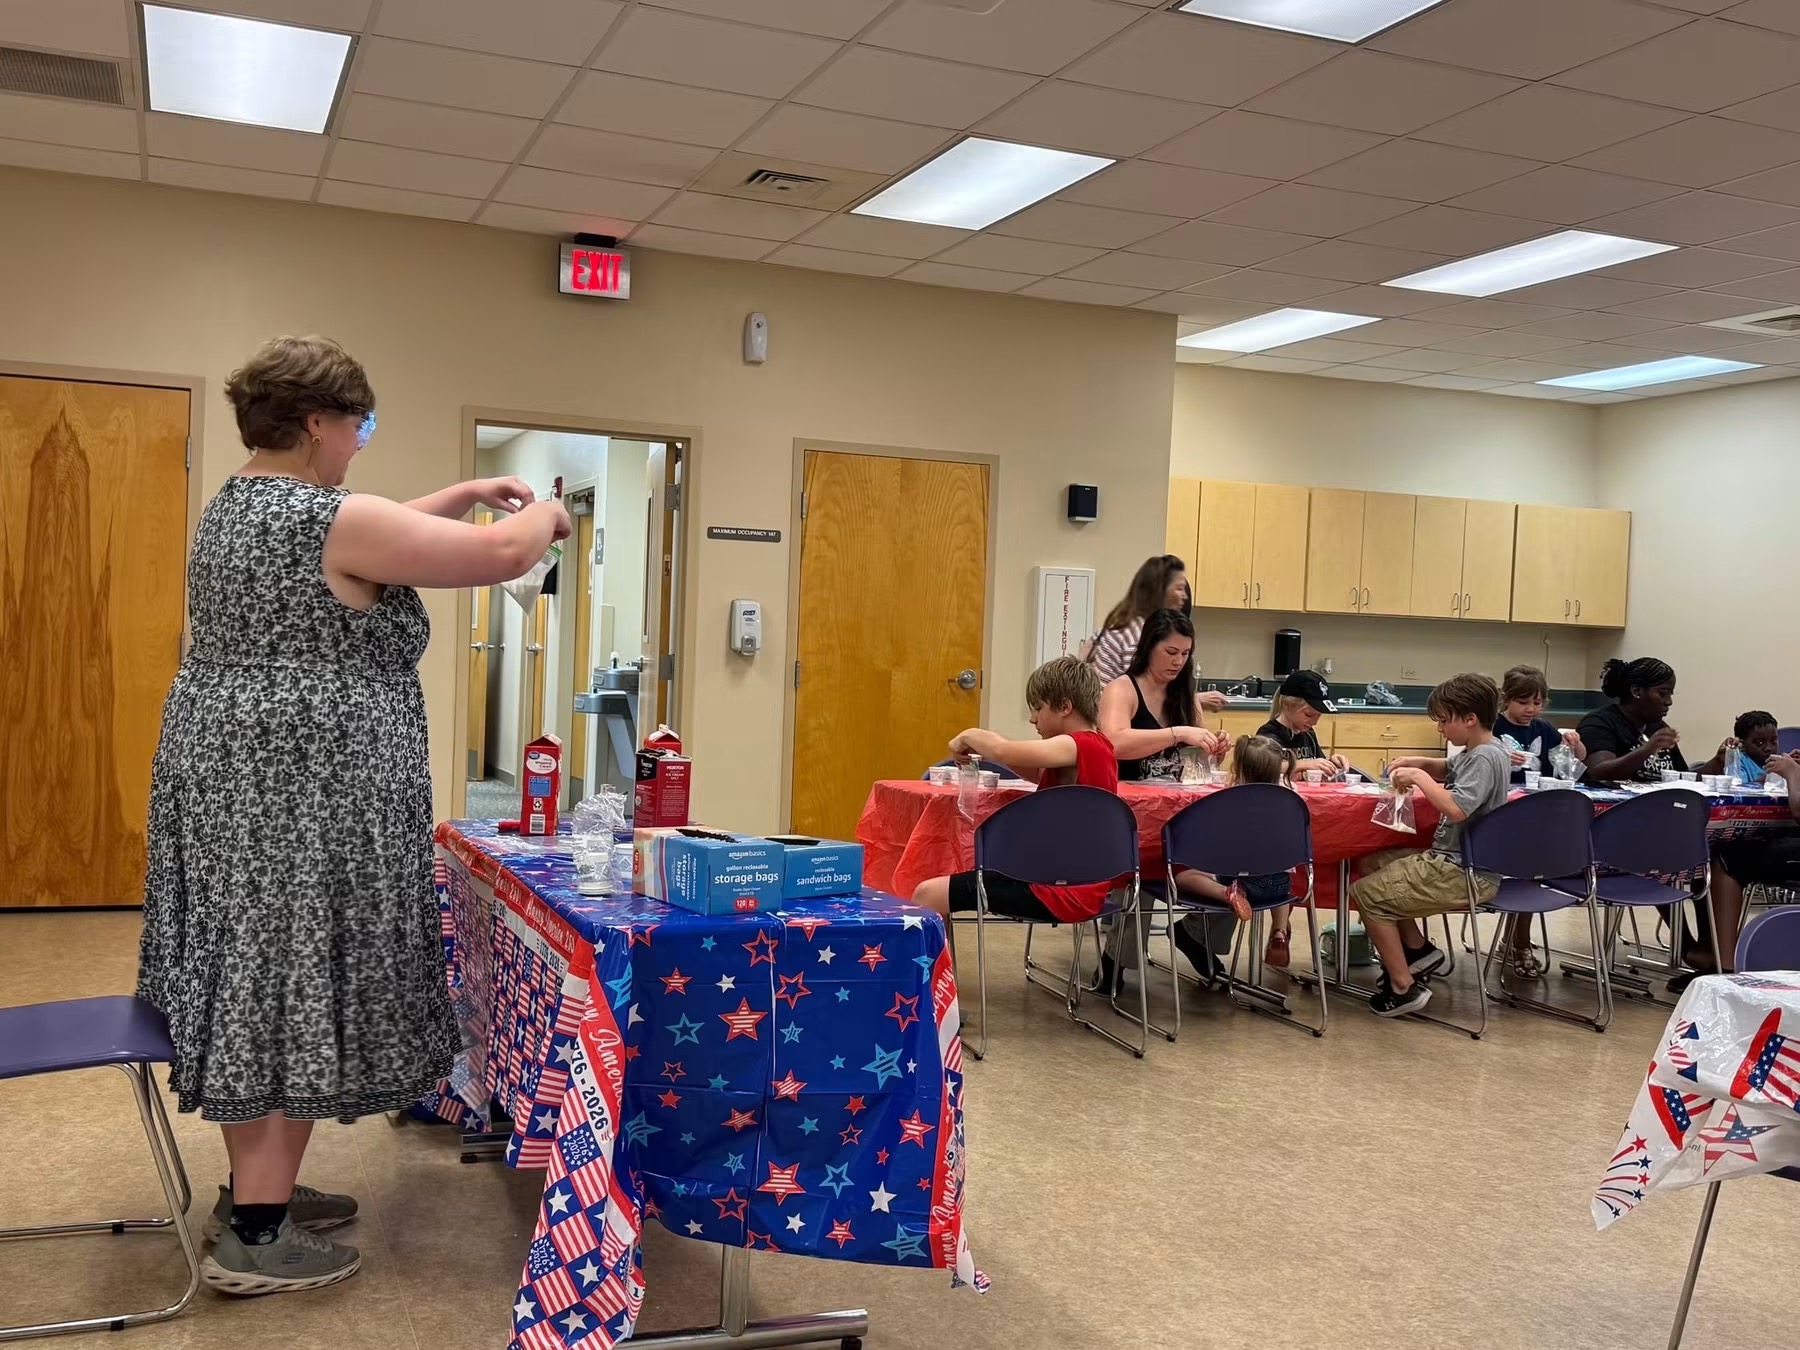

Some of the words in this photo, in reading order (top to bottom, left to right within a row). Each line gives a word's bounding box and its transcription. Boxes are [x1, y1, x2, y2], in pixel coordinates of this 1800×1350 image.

[572, 249, 624, 294] EXIT
[680, 854, 688, 897] storage
[714, 873, 753, 885] storage
[755, 871, 779, 883] bags
[796, 873, 832, 886] sandwich
[833, 872, 852, 884] bags
[581, 1086, 609, 1130] 2026
[568, 1139, 583, 1160] 2026
[576, 1135, 590, 1156] 1776
[532, 1248, 541, 1269] 2026
[539, 1244, 550, 1265] 1776
